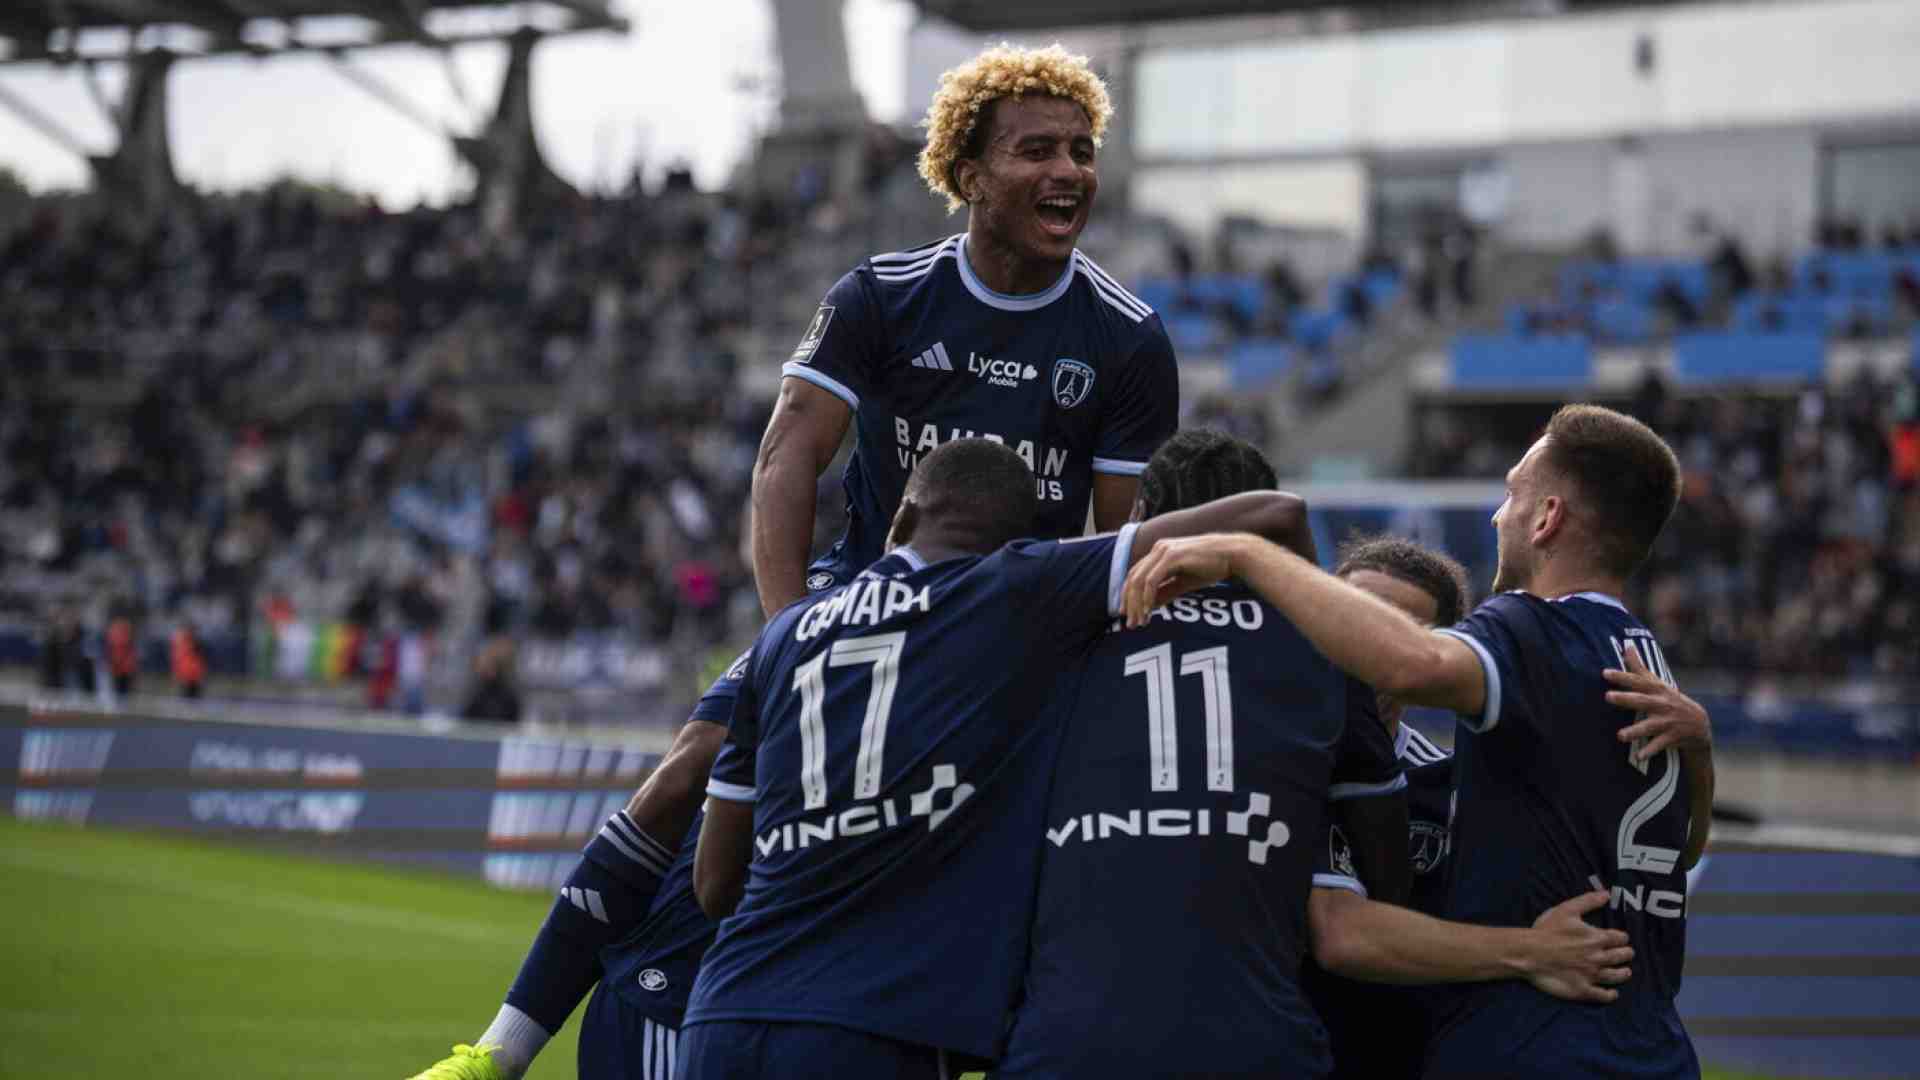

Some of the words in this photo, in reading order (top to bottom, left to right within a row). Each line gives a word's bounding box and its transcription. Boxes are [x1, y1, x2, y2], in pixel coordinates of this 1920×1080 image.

[968, 351, 1021, 377] Lyca
[895, 416, 1068, 477] BAAIN
[1111, 597, 1264, 632] ASSO
[792, 631, 907, 810] 17
[1124, 642, 1234, 792] 11
[1616, 712, 1681, 874] 2
[755, 799, 898, 857] VINCI
[1046, 809, 1210, 847] VINCI
[1588, 874, 1688, 920] INC
